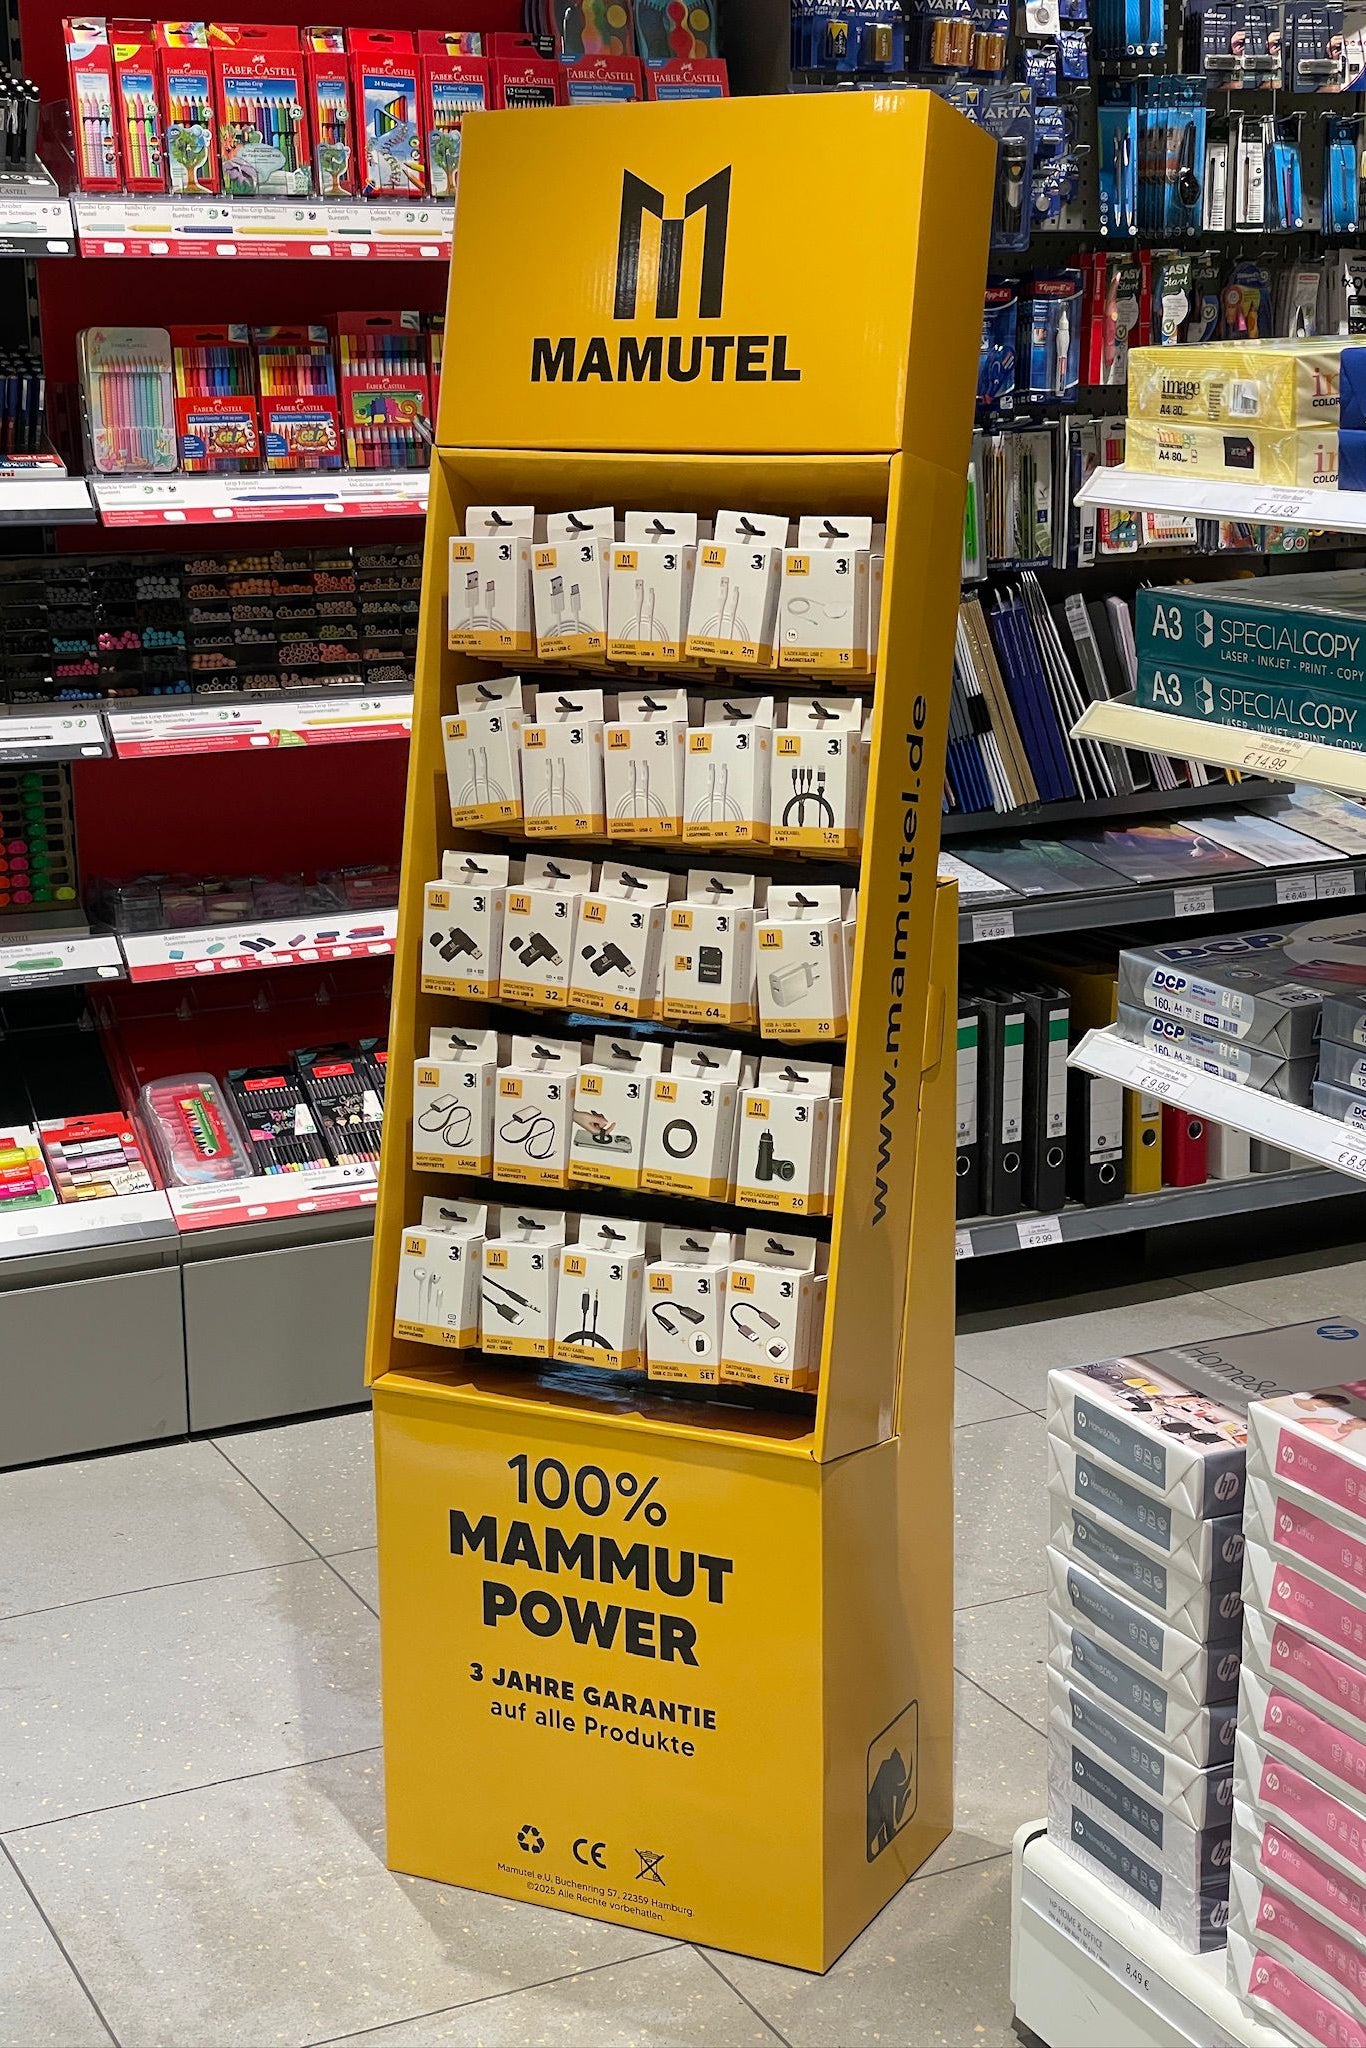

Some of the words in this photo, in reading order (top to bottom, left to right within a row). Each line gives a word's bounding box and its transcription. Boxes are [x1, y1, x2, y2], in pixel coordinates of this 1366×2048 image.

[222, 63, 297, 77] FABER-CASTELL
[362, 64, 416, 77] FABER-CASTELL
[1026, 59, 1057, 69] VARTA
[430, 71, 483, 82] FABER-CASTELL
[503, 74, 555, 85] FABER-CASTELL
[566, 67, 635, 82] FABER-CASTELL
[653, 72, 722, 84] FABER-CASTELL
[226, 80, 235, 88] 12
[530, 335, 801, 382] MAMUTEL
[1161, 376, 1200, 400] image
[1160, 404, 1171, 415] A4
[1172, 405, 1183, 416] 80
[1156, 428, 1197, 449] image
[1158, 450, 1170, 460] A4
[1172, 452, 1182, 462] 80
[499, 544, 510, 560] 3
[580, 546, 591, 562] 3
[664, 554, 675, 570] 3
[750, 554, 762, 570] 3
[836, 559, 847, 574] 3
[588, 636, 600, 645] 2m
[1152, 604, 1183, 641] A3
[1220, 619, 1361, 662] SPECIALCOPY
[662, 646, 675, 654] 1m
[742, 646, 755, 656] 2m
[1220, 650, 1249, 664] LASER
[1257, 655, 1290, 670] INKJET
[1300, 661, 1328, 676] PRINT
[1336, 667, 1365, 682] COPY
[1152, 670, 1183, 707] A3
[1219, 687, 1358, 733] SPECIALCOPY
[489, 718, 500, 732] 3
[570, 730, 581, 744] 3
[655, 730, 666, 746] 3
[736, 734, 747, 750] 3
[1336, 738, 1364, 751] COPY
[827, 740, 839, 755] 3
[1243, 752, 1252, 764] €
[500, 806, 512, 814] 1m
[575, 819, 588, 827] 2m
[474, 896, 484, 912] 3
[554, 902, 566, 918] 3
[630, 913, 641, 928] 3
[716, 916, 727, 932] 3
[810, 931, 821, 946] 3
[1159, 932, 1286, 961] DCP
[872, 695, 927, 1226] www.mamutel.de
[1152, 971, 1187, 991] DCP
[468, 984, 480, 994] 16
[545, 990, 558, 1000] 32
[614, 1002, 628, 1012] 64
[706, 1008, 720, 1017] 64
[1174, 1004, 1182, 1013] A4
[818, 1022, 830, 1030] 20
[1152, 1018, 1185, 1039] DCP
[464, 1073, 474, 1088] 3
[548, 1085, 559, 1100] 3
[626, 1084, 638, 1098] 3
[700, 1090, 712, 1106] 3
[794, 1106, 806, 1122] 3
[792, 1198, 804, 1206] 20
[448, 1246, 460, 1260] 3
[531, 1254, 542, 1270] 3
[610, 1264, 621, 1280] 3
[697, 1278, 708, 1294] 3
[780, 1282, 791, 1297] 3
[533, 1343, 546, 1351] 1m
[606, 1354, 618, 1363] 1m
[700, 1371, 715, 1380] SET
[773, 1376, 789, 1384] SET
[1298, 1456, 1318, 1473] Office
[507, 1454, 667, 1527] 100%
[1214, 1472, 1240, 1501] hp
[1280, 1514, 1293, 1532] hp
[449, 1509, 733, 1604] MAMMUT
[1222, 1535, 1245, 1564] hp
[1278, 1580, 1291, 1600] hp
[482, 1580, 700, 1667] POWER
[1218, 1654, 1240, 1682] hp
[469, 1662, 484, 1681] 3
[492, 1667, 575, 1702] JAHRE
[583, 1686, 717, 1730] GARANTIE
[490, 1701, 527, 1722] auf
[535, 1708, 576, 1732] alle
[584, 1716, 696, 1757] Produkte
[1267, 1836, 1279, 1856] hp
[1282, 1848, 1301, 1867] Office
[497, 1862, 535, 1879] Mamutel
[555, 1876, 605, 1896] Buchenring
[622, 1892, 649, 1905] 22359
[558, 1889, 574, 1900] Alle
[576, 1894, 607, 1908] Rechte
[1058, 1906, 1076, 1928] HOME
[1083, 1927, 1103, 1952] OFFICE
[1125, 1963, 1143, 1984] 8,49
[1144, 1979, 1150, 1991] €
